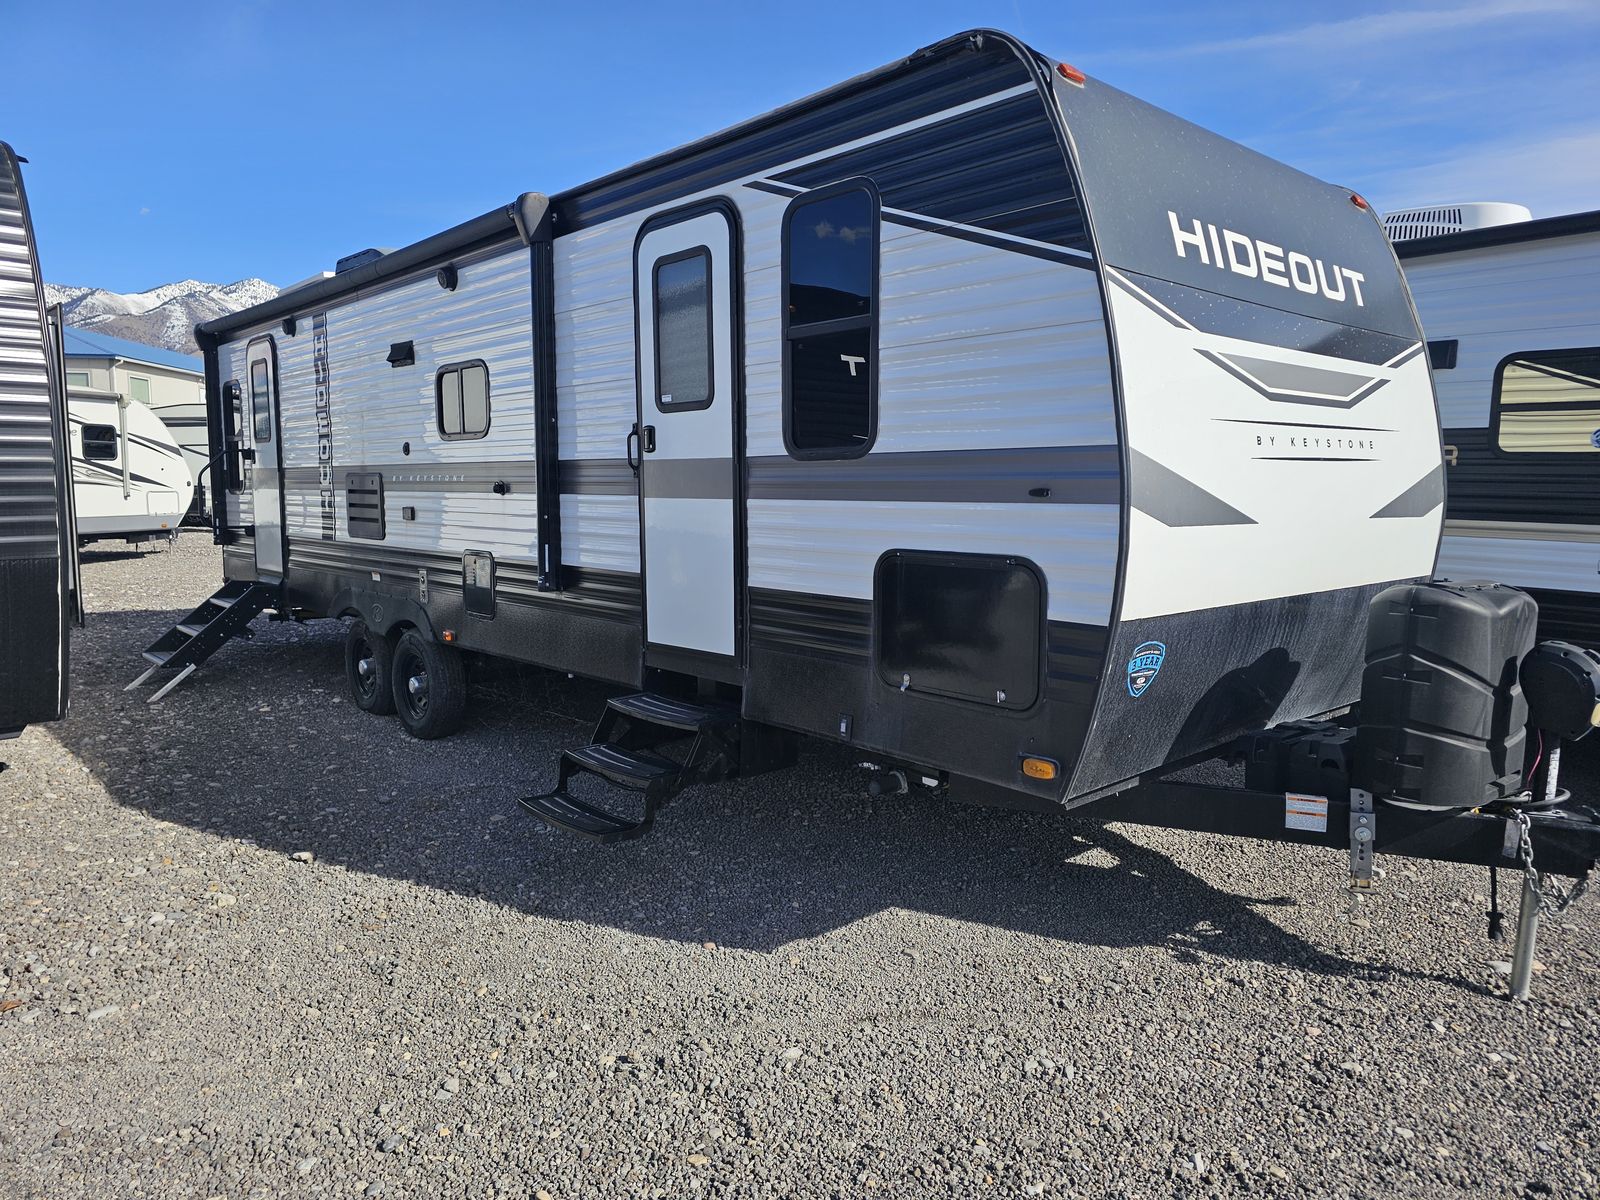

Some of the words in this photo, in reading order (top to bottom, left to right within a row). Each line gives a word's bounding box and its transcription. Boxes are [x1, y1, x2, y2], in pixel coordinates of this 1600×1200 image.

[1167, 210, 1366, 307] HIDEOUT
[1256, 435, 1276, 447] BY
[1290, 436, 1374, 450] KEYSTONE
[409, 474, 465, 482] KEYSTONE
[1131, 660, 1137, 671] 3
[1139, 655, 1160, 668] YEAR
